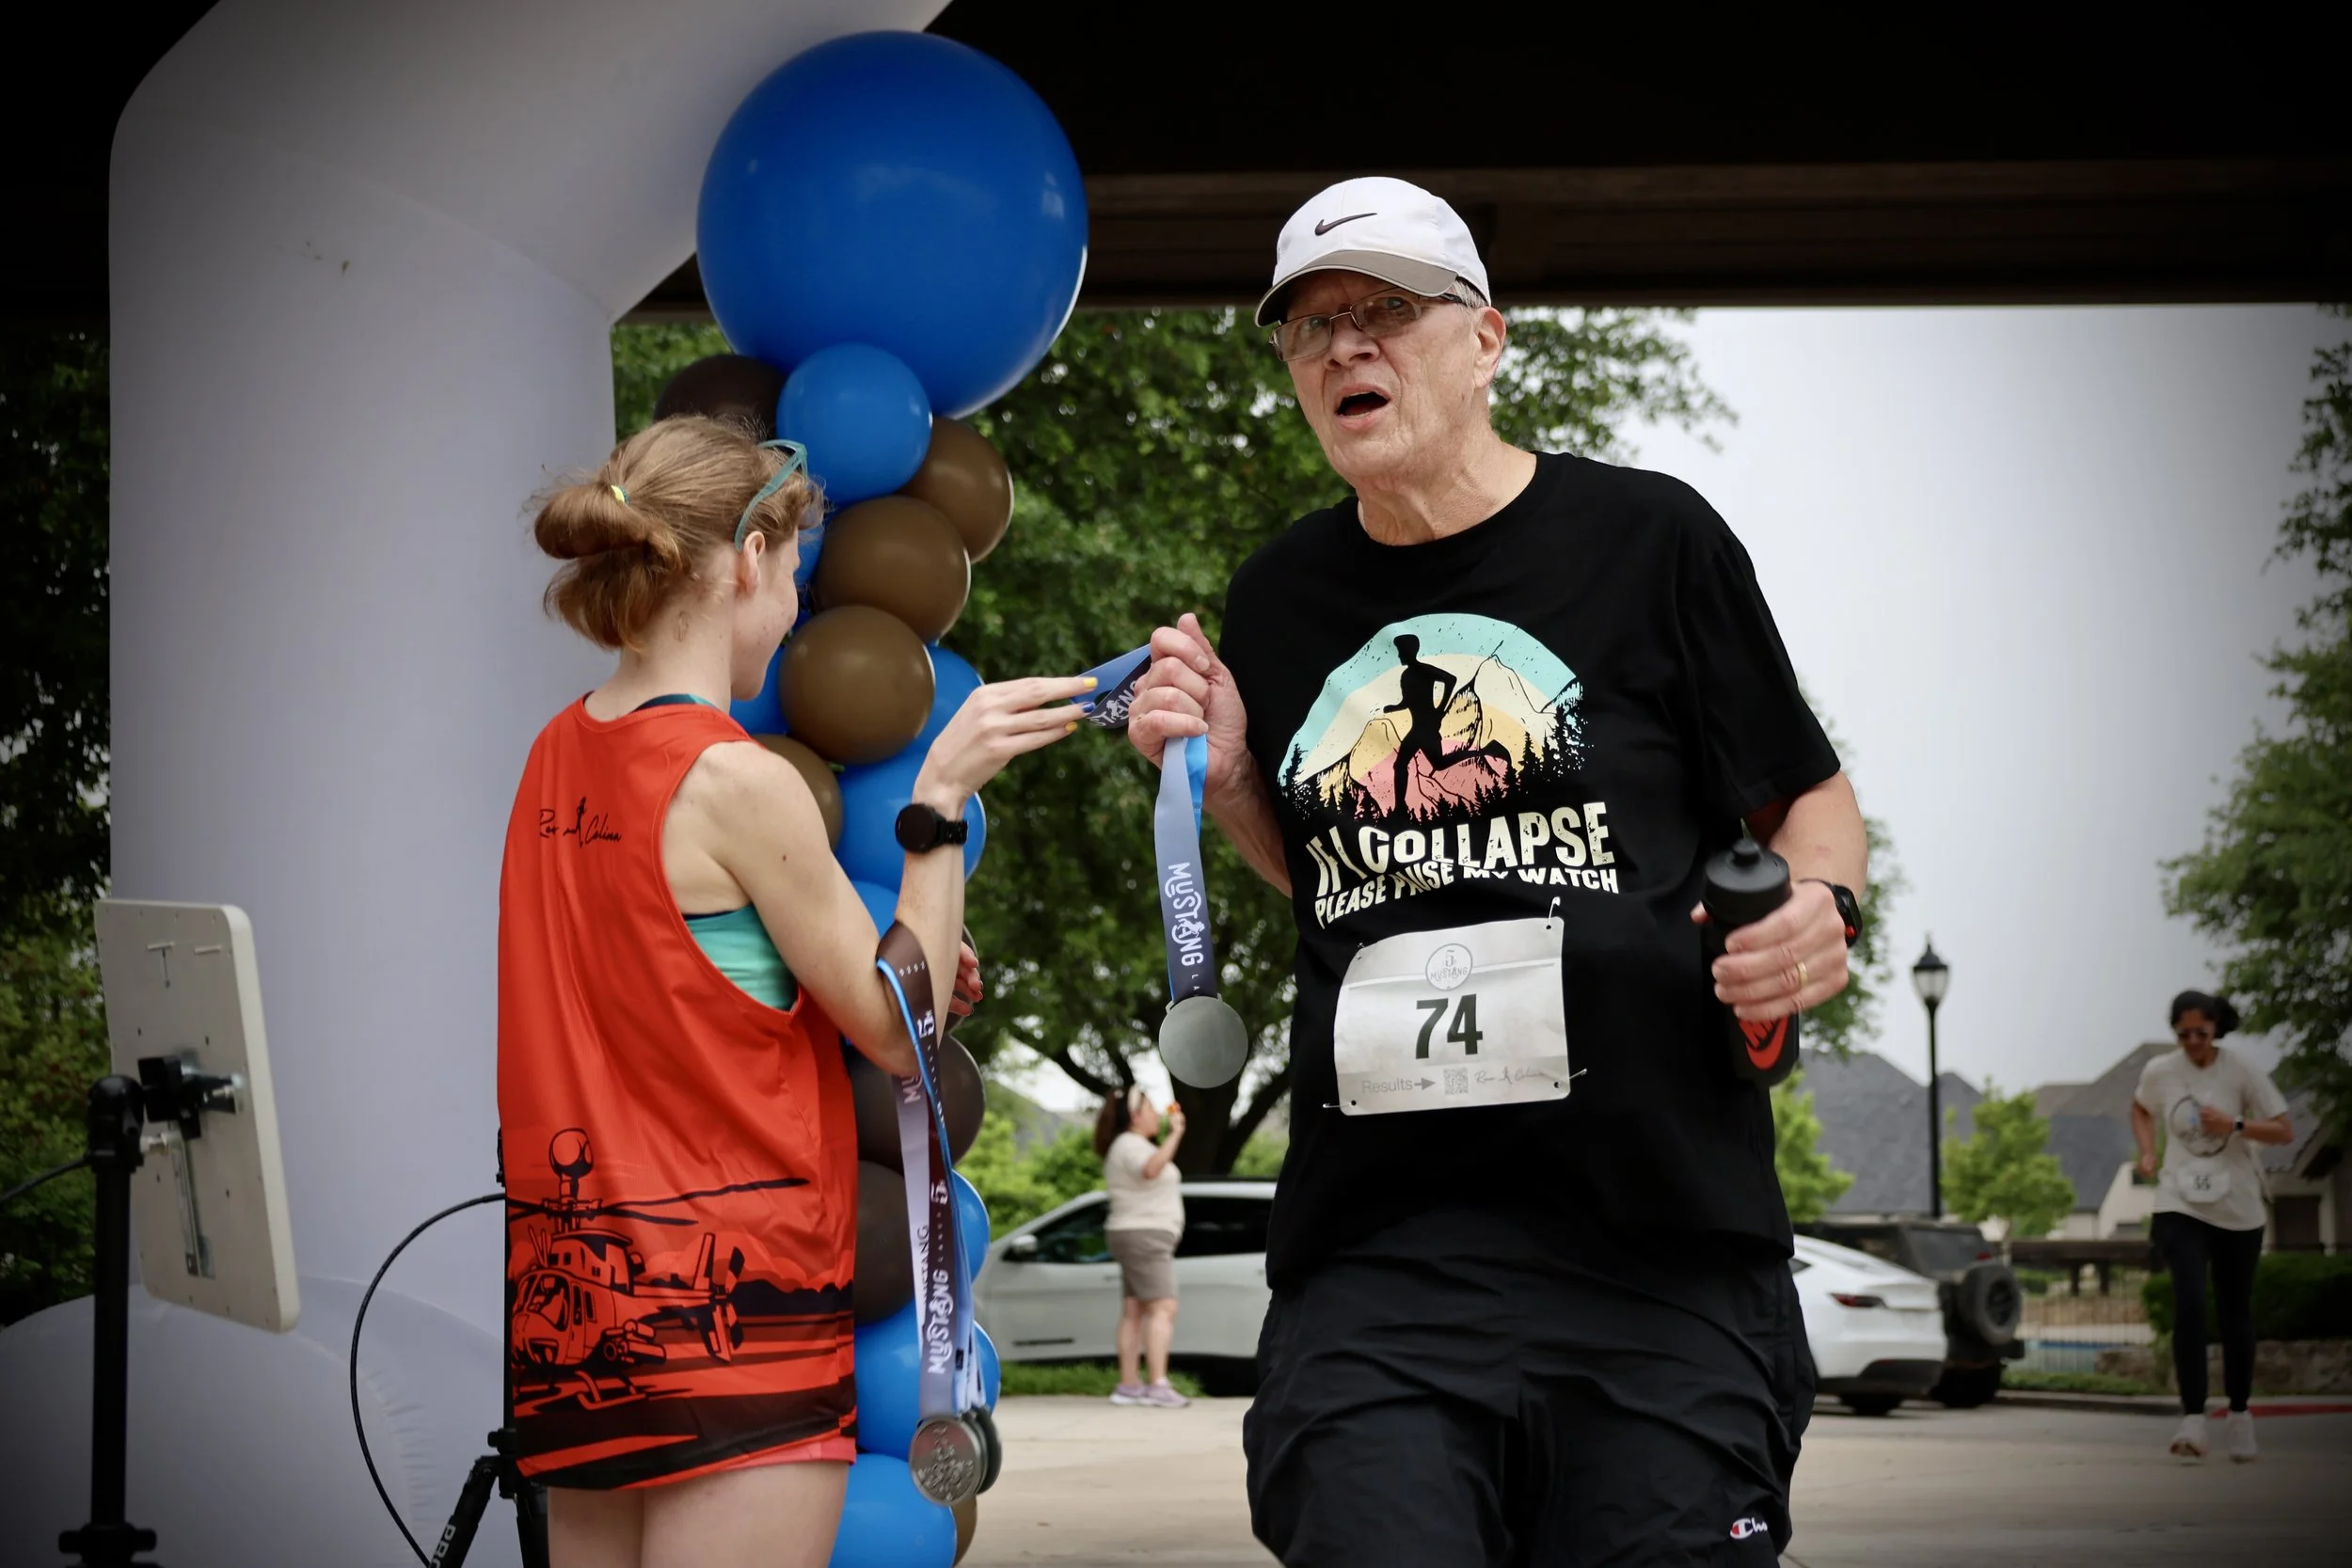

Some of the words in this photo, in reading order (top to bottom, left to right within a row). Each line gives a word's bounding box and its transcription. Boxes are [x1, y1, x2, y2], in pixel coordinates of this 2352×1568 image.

[1359, 801, 1615, 874] COLLAPSE
[1165, 862, 1205, 966] MUSTANG
[1314, 875, 1387, 930] PLEASE
[1517, 867, 1619, 894] WATCH
[1430, 966, 1468, 981] MUSTANG
[1415, 993, 1483, 1059] 74
[1363, 1077, 1414, 1094] Results
[927, 1269, 953, 1374] MUSTANG
